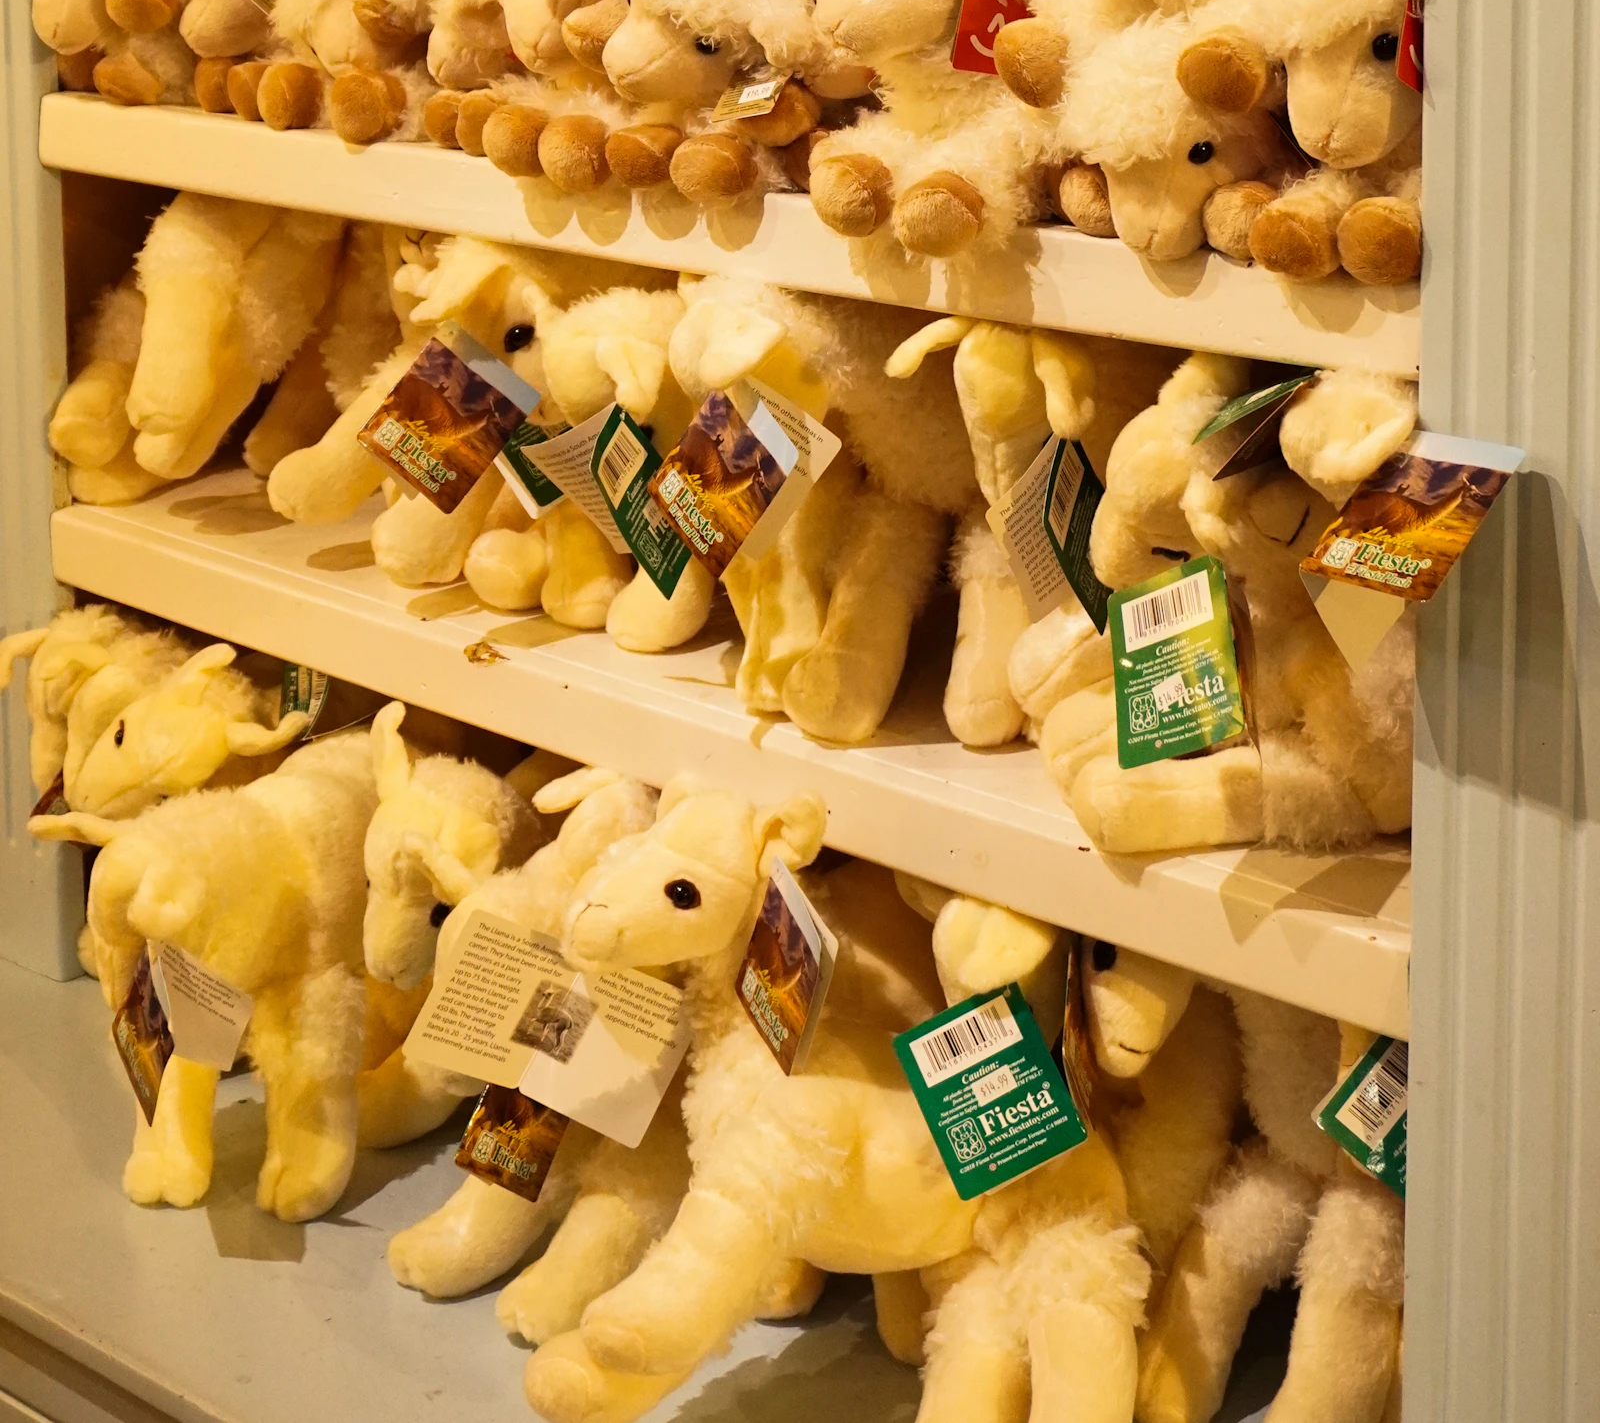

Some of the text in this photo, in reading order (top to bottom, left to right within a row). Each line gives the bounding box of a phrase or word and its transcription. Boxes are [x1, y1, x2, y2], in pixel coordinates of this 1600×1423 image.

[792, 463, 809, 478] asily.
[1156, 639, 1190, 657] Caution:
[1158, 683, 1184, 706] $14.99
[1162, 694, 1228, 724] www.fiestatoy.com
[479, 922, 491, 932] The
[490, 927, 510, 939] Llama
[522, 938, 540, 950] South
[468, 941, 563, 977] camel. They have been used for
[473, 932, 516, 951] domesticated
[516, 948, 539, 959] relative
[546, 958, 559, 966] the
[459, 960, 481, 970] animal
[480, 967, 494, 975] and
[505, 975, 522, 985] carry
[464, 950, 492, 964] centuries
[504, 965, 521, 974] pack
[455, 978, 467, 986] full
[466, 983, 487, 993] grown
[487, 989, 507, 1000] Llama
[472, 973, 481, 981] 75
[480, 976, 490, 984] lbs
[617, 973, 629, 982] live
[629, 980, 644, 989] with
[644, 986, 662, 996] other
[440, 996, 454, 1004] and
[466, 1004, 488, 1014] weight
[497, 1013, 505, 1021] to
[445, 987, 462, 996] grow
[471, 994, 479, 1002] to
[484, 998, 498, 1007] feet
[497, 1003, 509, 1011] tall
[594, 986, 618, 1000] curious
[618, 998, 643, 1011] animals
[651, 1012, 666, 1020] well
[667, 1018, 679, 1026] and
[619, 984, 635, 998] They
[634, 993, 646, 1001] are
[645, 998, 678, 1016] extremely
[436, 1004, 449, 1012] 450
[459, 1011, 472, 1020] The
[471, 1016, 496, 1028] average
[442, 1017, 457, 1025] span
[457, 1021, 468, 1029] for
[472, 1026, 495, 1039] healthy
[605, 1014, 636, 1030] approach
[635, 1027, 659, 1040] people
[608, 1004, 655, 1028] will most likely
[427, 1021, 444, 1032] llama
[450, 1029, 460, 1037] 20
[463, 1033, 472, 1041] 25
[489, 1042, 511, 1054] Llamas
[432, 1035, 464, 1050] extremely
[464, 1045, 483, 1055] social
[482, 1051, 506, 1062] animals
[962, 1060, 999, 1085] Caution:
[980, 1073, 1010, 1098] $14.99
[988, 1106, 1059, 1146] www.fiestatoy.com
